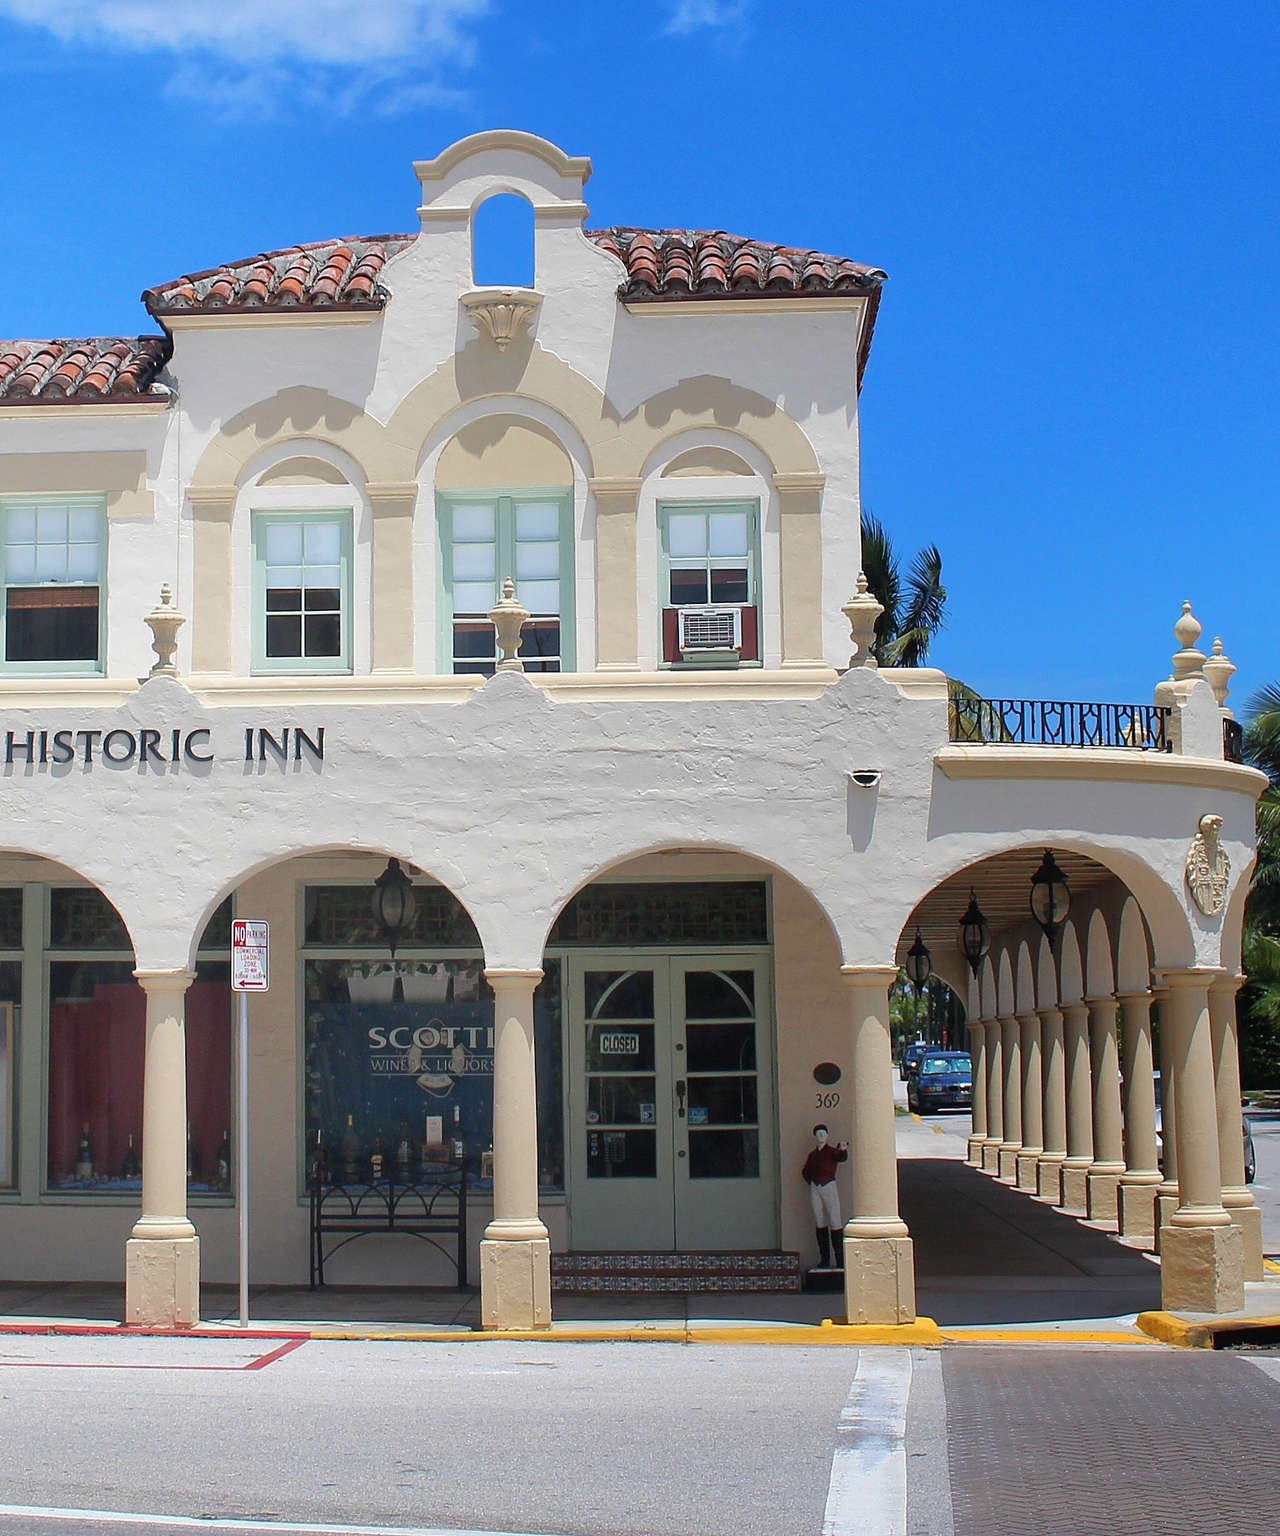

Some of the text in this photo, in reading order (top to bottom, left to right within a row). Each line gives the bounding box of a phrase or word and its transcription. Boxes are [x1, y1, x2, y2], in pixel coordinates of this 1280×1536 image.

[5, 729, 214, 763] HISTORIC
[245, 727, 324, 761] INN
[235, 926, 246, 942] NO
[602, 1035, 637, 1052] CLOSED
[815, 1093, 840, 1109] 369
